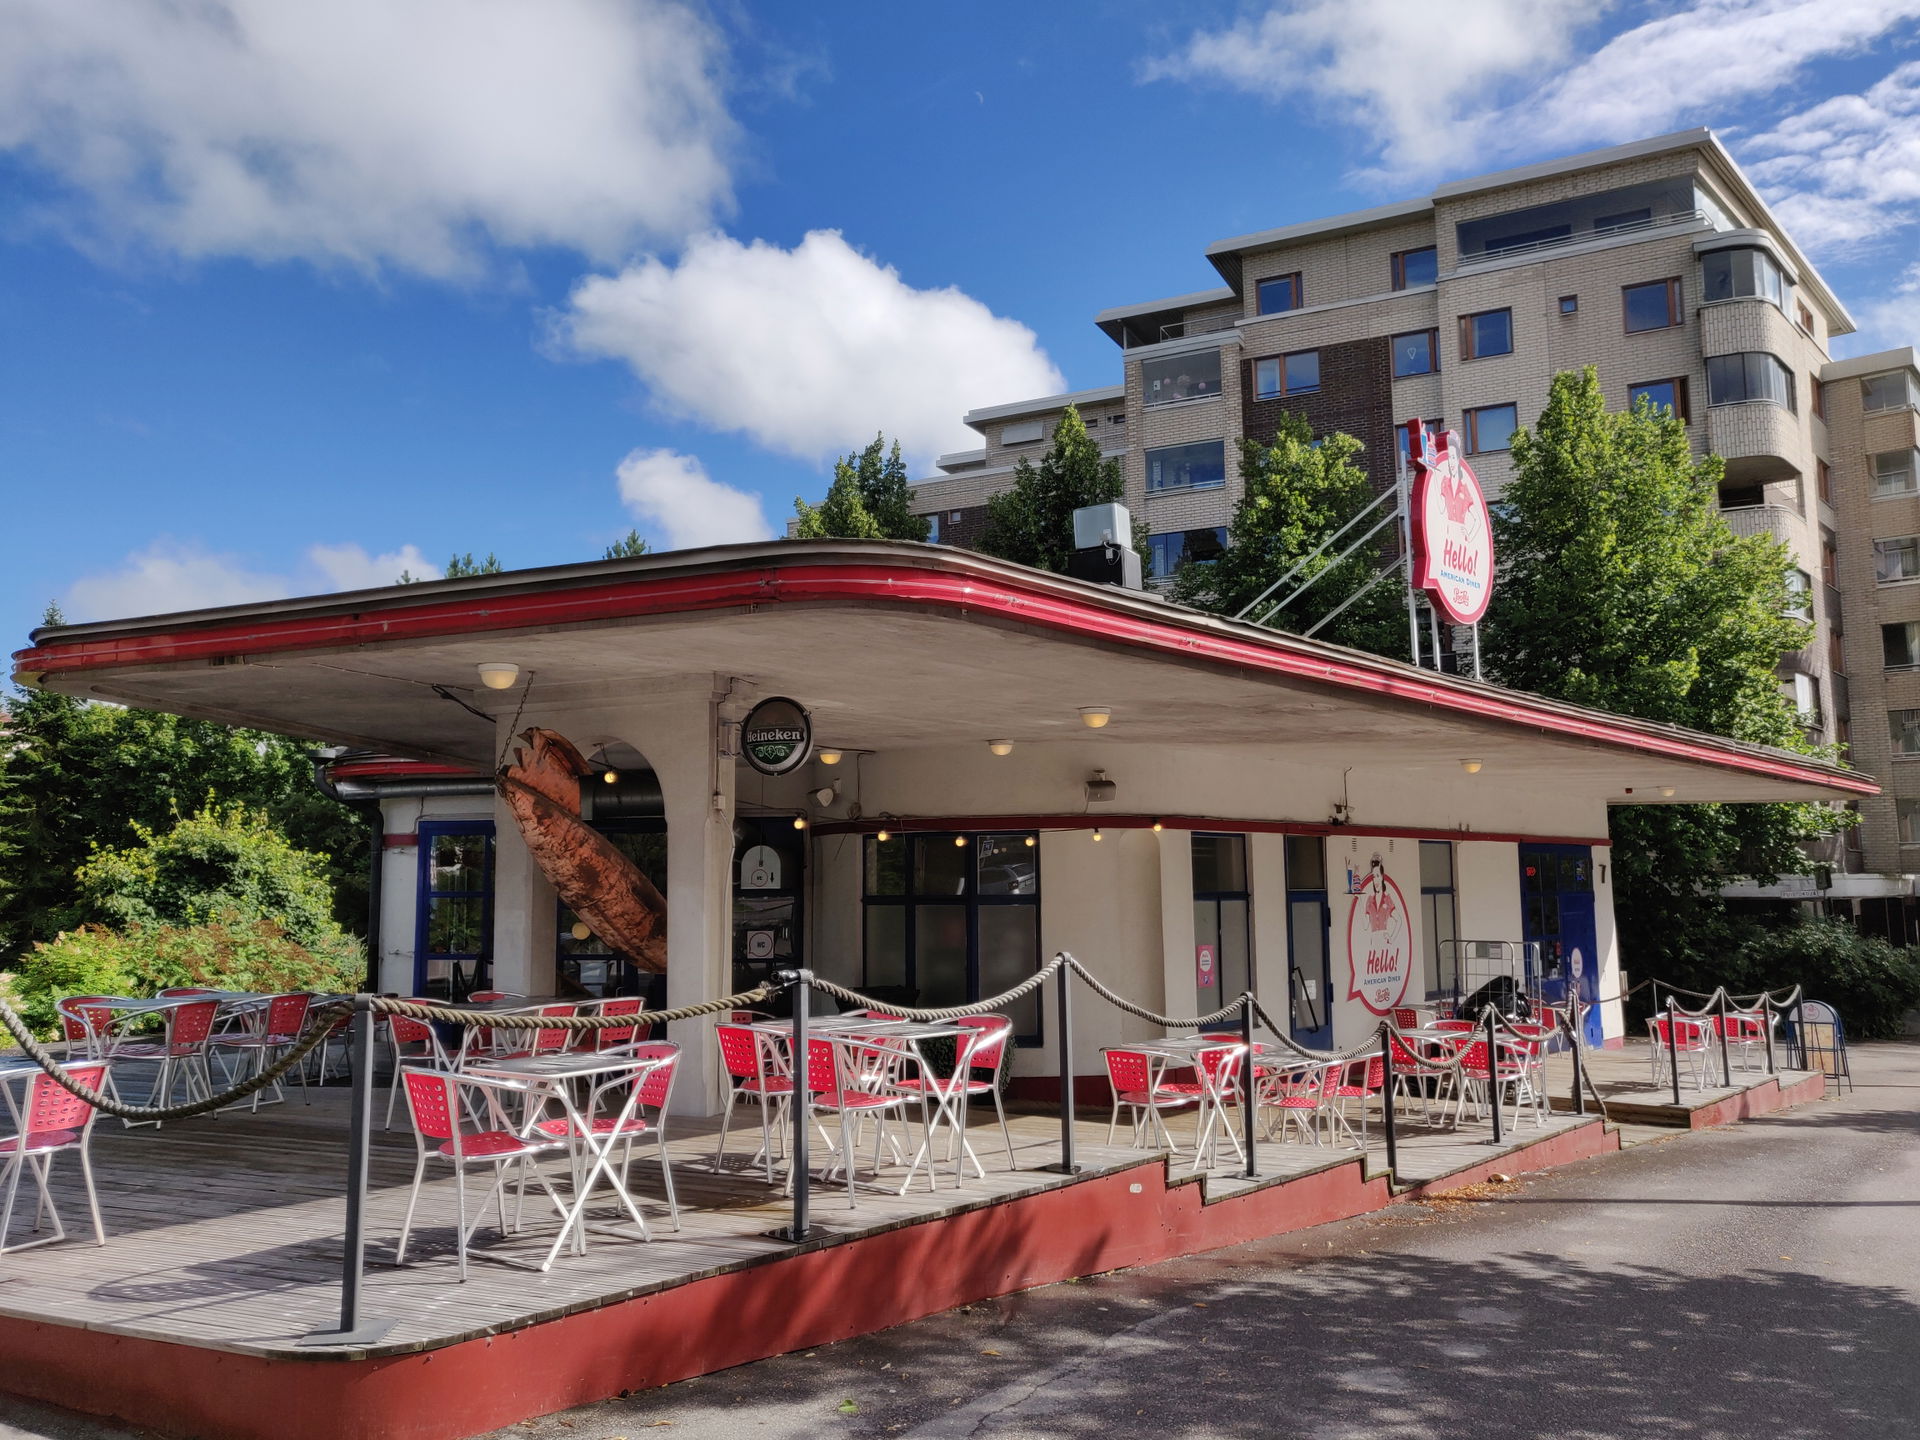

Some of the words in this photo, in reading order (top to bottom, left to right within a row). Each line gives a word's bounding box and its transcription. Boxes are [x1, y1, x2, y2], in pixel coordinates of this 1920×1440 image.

[1443, 538, 1478, 576] Hello!
[1441, 570, 1465, 583] AMERICAN
[1466, 578, 1480, 588] DINER
[747, 729, 801, 743] Heineken
[1598, 864, 1606, 884] 7
[1367, 948, 1399, 975] Hello!
[1364, 977, 1387, 985] AMERICAN
